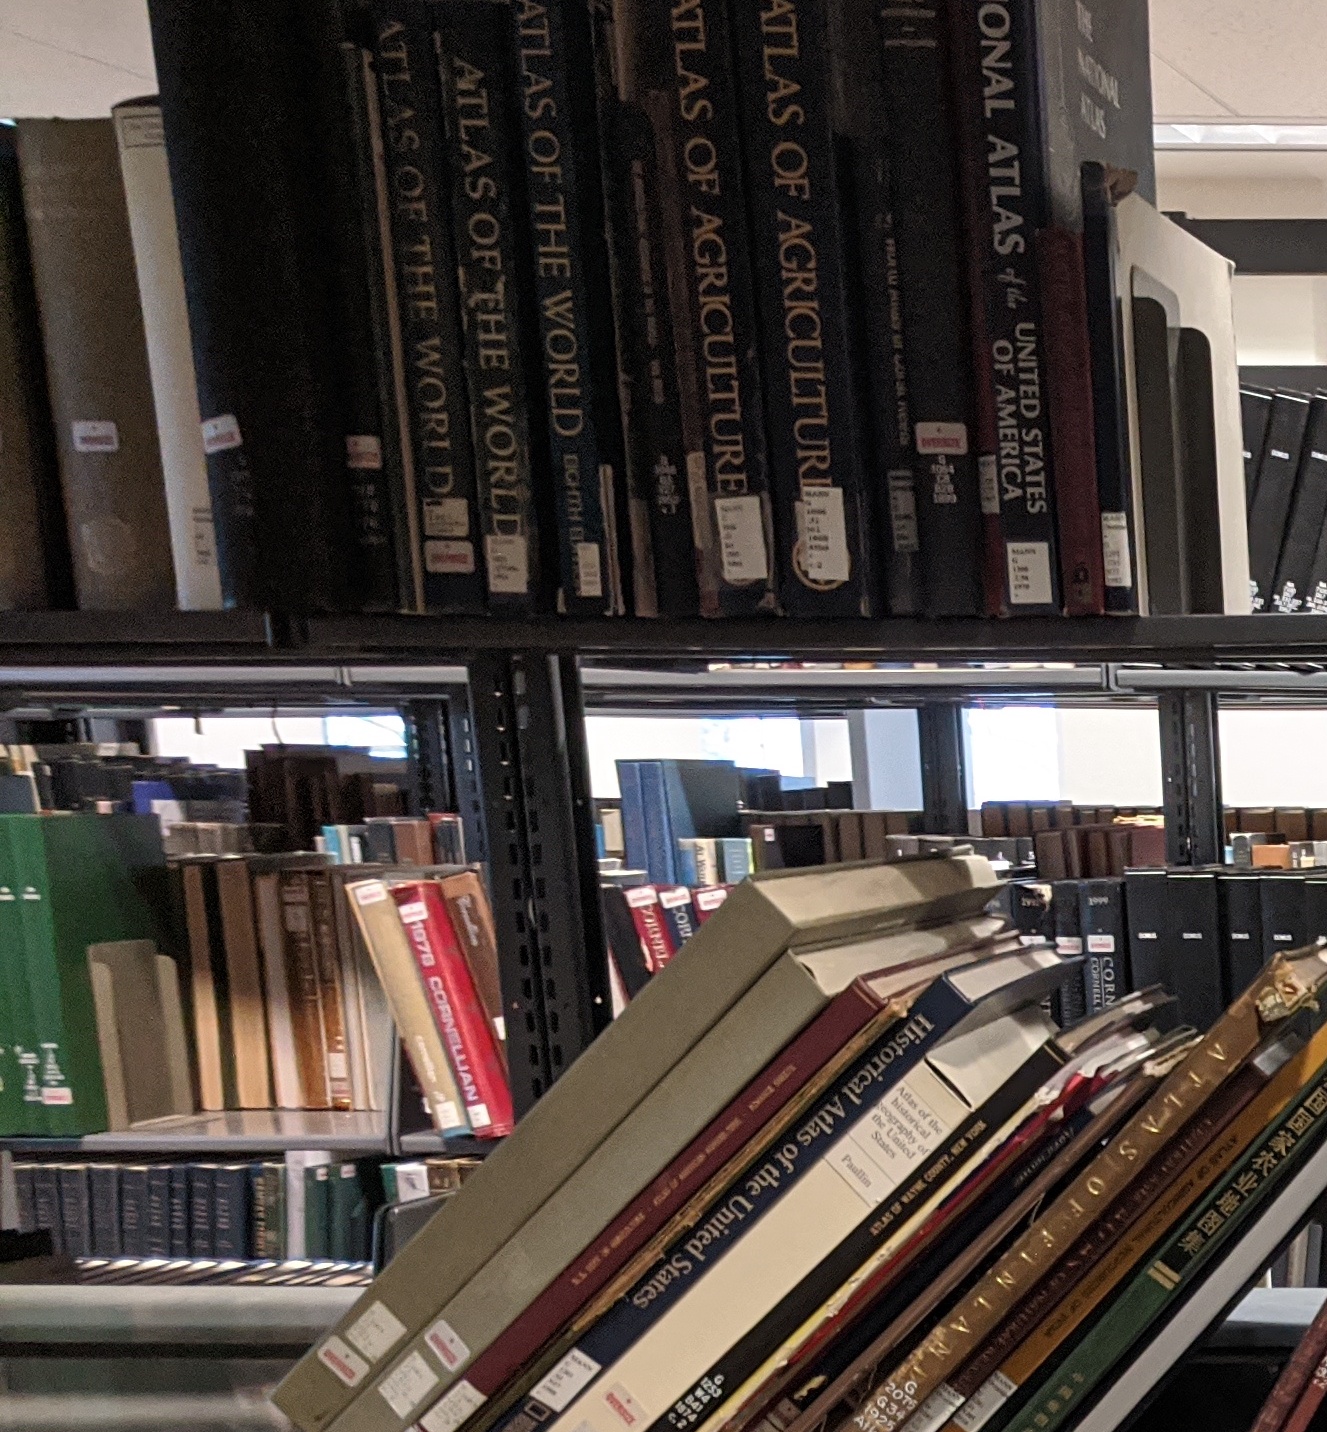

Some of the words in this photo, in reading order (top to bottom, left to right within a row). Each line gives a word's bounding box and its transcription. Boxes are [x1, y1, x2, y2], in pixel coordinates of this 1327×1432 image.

[518, 0, 556, 121] ATLAS
[760, 0, 806, 126] ATLAS
[454, 57, 497, 201] ATLAS
[527, 130, 560, 186] OF
[683, 137, 722, 195] OF
[772, 141, 811, 199] OF
[987, 133, 1026, 256] ATLAS
[468, 211, 501, 270] OF
[534, 194, 570, 280] THE
[542, 289, 583, 437] WORLD
[690, 206, 749, 494] AGRICULTURE
[991, 338, 1015, 378] OF
[1014, 321, 1040, 420] UNITED
[482, 386, 521, 536] WORLD
[995, 382, 1023, 501] AMERICA
[1021, 426, 1048, 515] STATES
[428, 975, 480, 1103] CORNELLIAN
[849, 1012, 935, 1106] Historical
[796, 1092, 848, 1147] Atlas
[871, 1112, 887, 1130] the
[886, 1128, 917, 1160] United
[890, 1097, 932, 1140] historical
[896, 1085, 919, 1110] Atlas
[929, 1116, 944, 1135] the
[778, 1143, 799, 1175] of
[840, 1153, 873, 1189] Paullin
[870, 1129, 897, 1160] States
[745, 1161, 781, 1196] the
[686, 1193, 754, 1262] United
[632, 1248, 692, 1308] States
[904, 1380, 918, 1396] G
